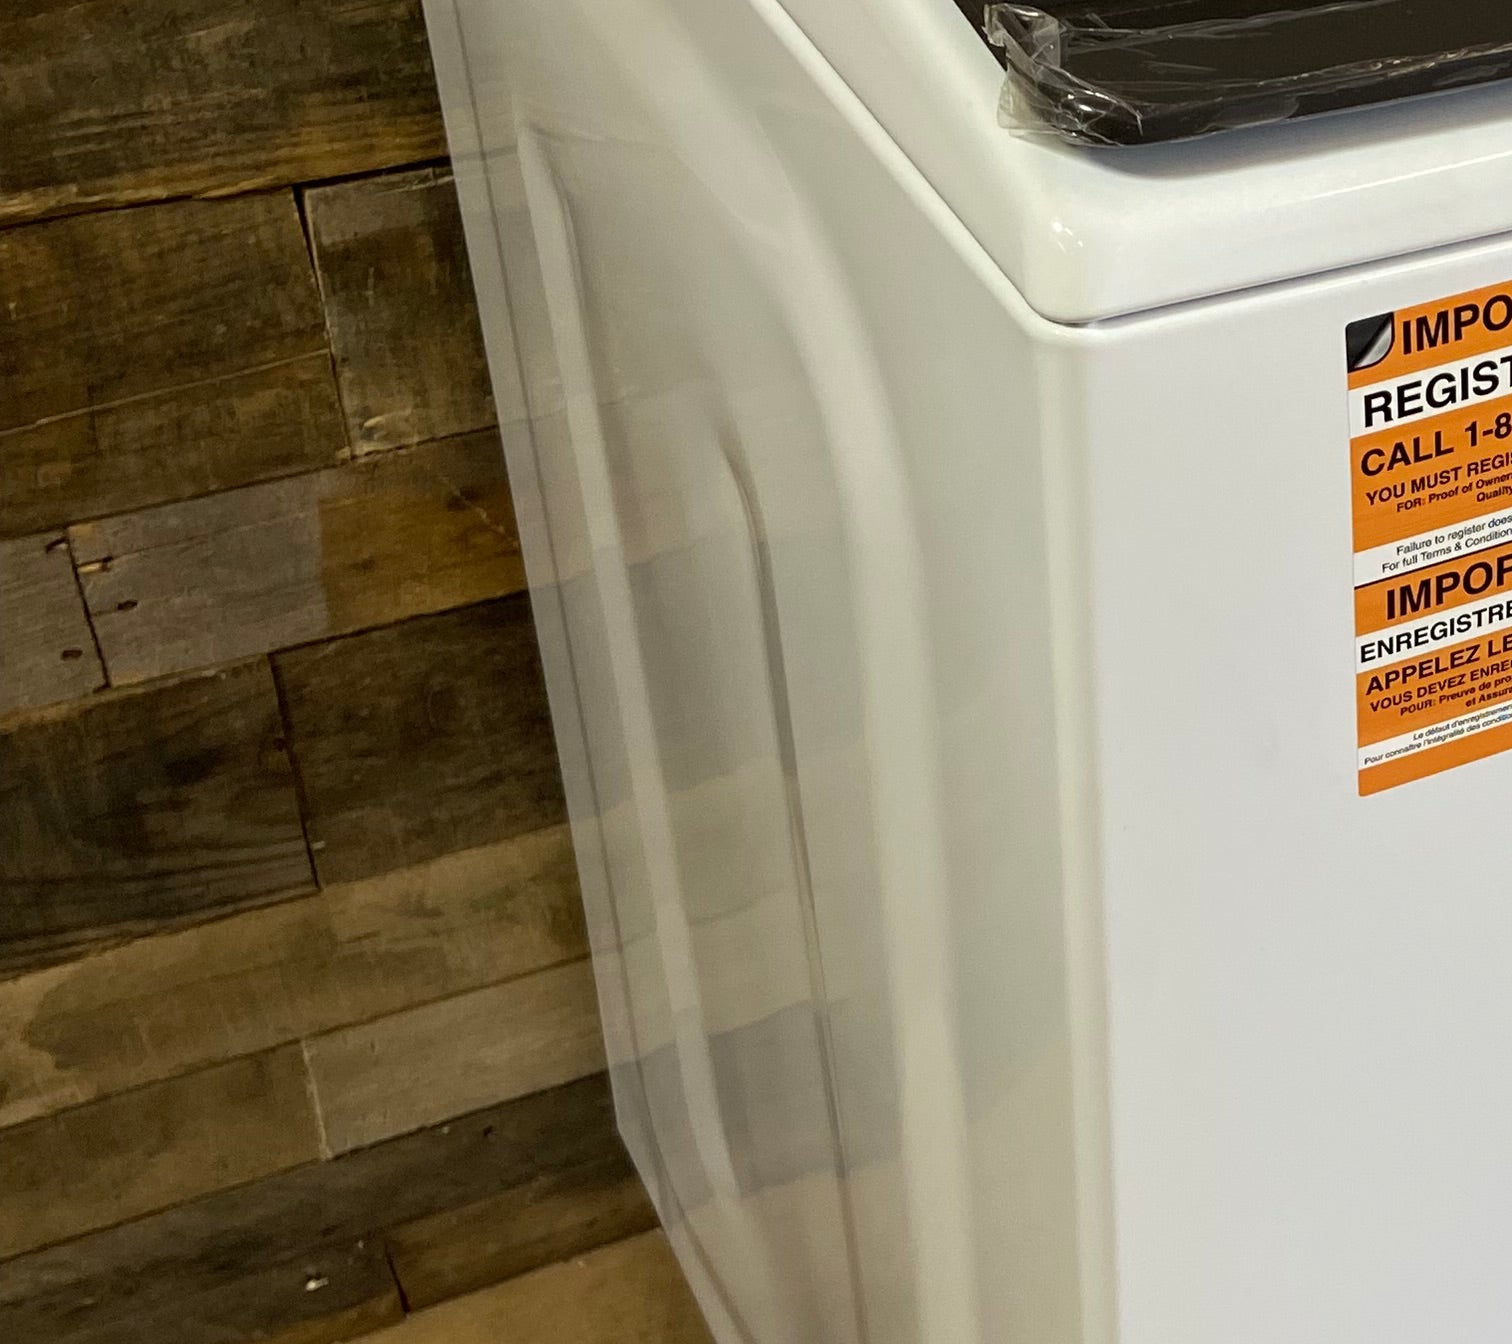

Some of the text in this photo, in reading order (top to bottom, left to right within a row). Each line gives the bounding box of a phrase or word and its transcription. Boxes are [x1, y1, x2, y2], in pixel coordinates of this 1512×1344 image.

[1361, 430, 1455, 477] CALL
[1366, 482, 1405, 506] YOU
[1411, 466, 1462, 495] MUST
[1397, 497, 1425, 513] FOR:
[1429, 487, 1459, 504] Proof
[1462, 482, 1474, 496] of
[1397, 538, 1432, 555] Failure
[1435, 534, 1444, 544] to
[1447, 522, 1485, 540] register
[1488, 515, 1512, 528] does
[1382, 562, 1400, 573] For
[1402, 555, 1418, 566] full
[1421, 547, 1452, 562] Terms
[1454, 543, 1462, 551] &
[1366, 644, 1480, 695] APPELEZ
[1370, 689, 1412, 712] VOUS
[1417, 676, 1467, 698] DEVEZ
